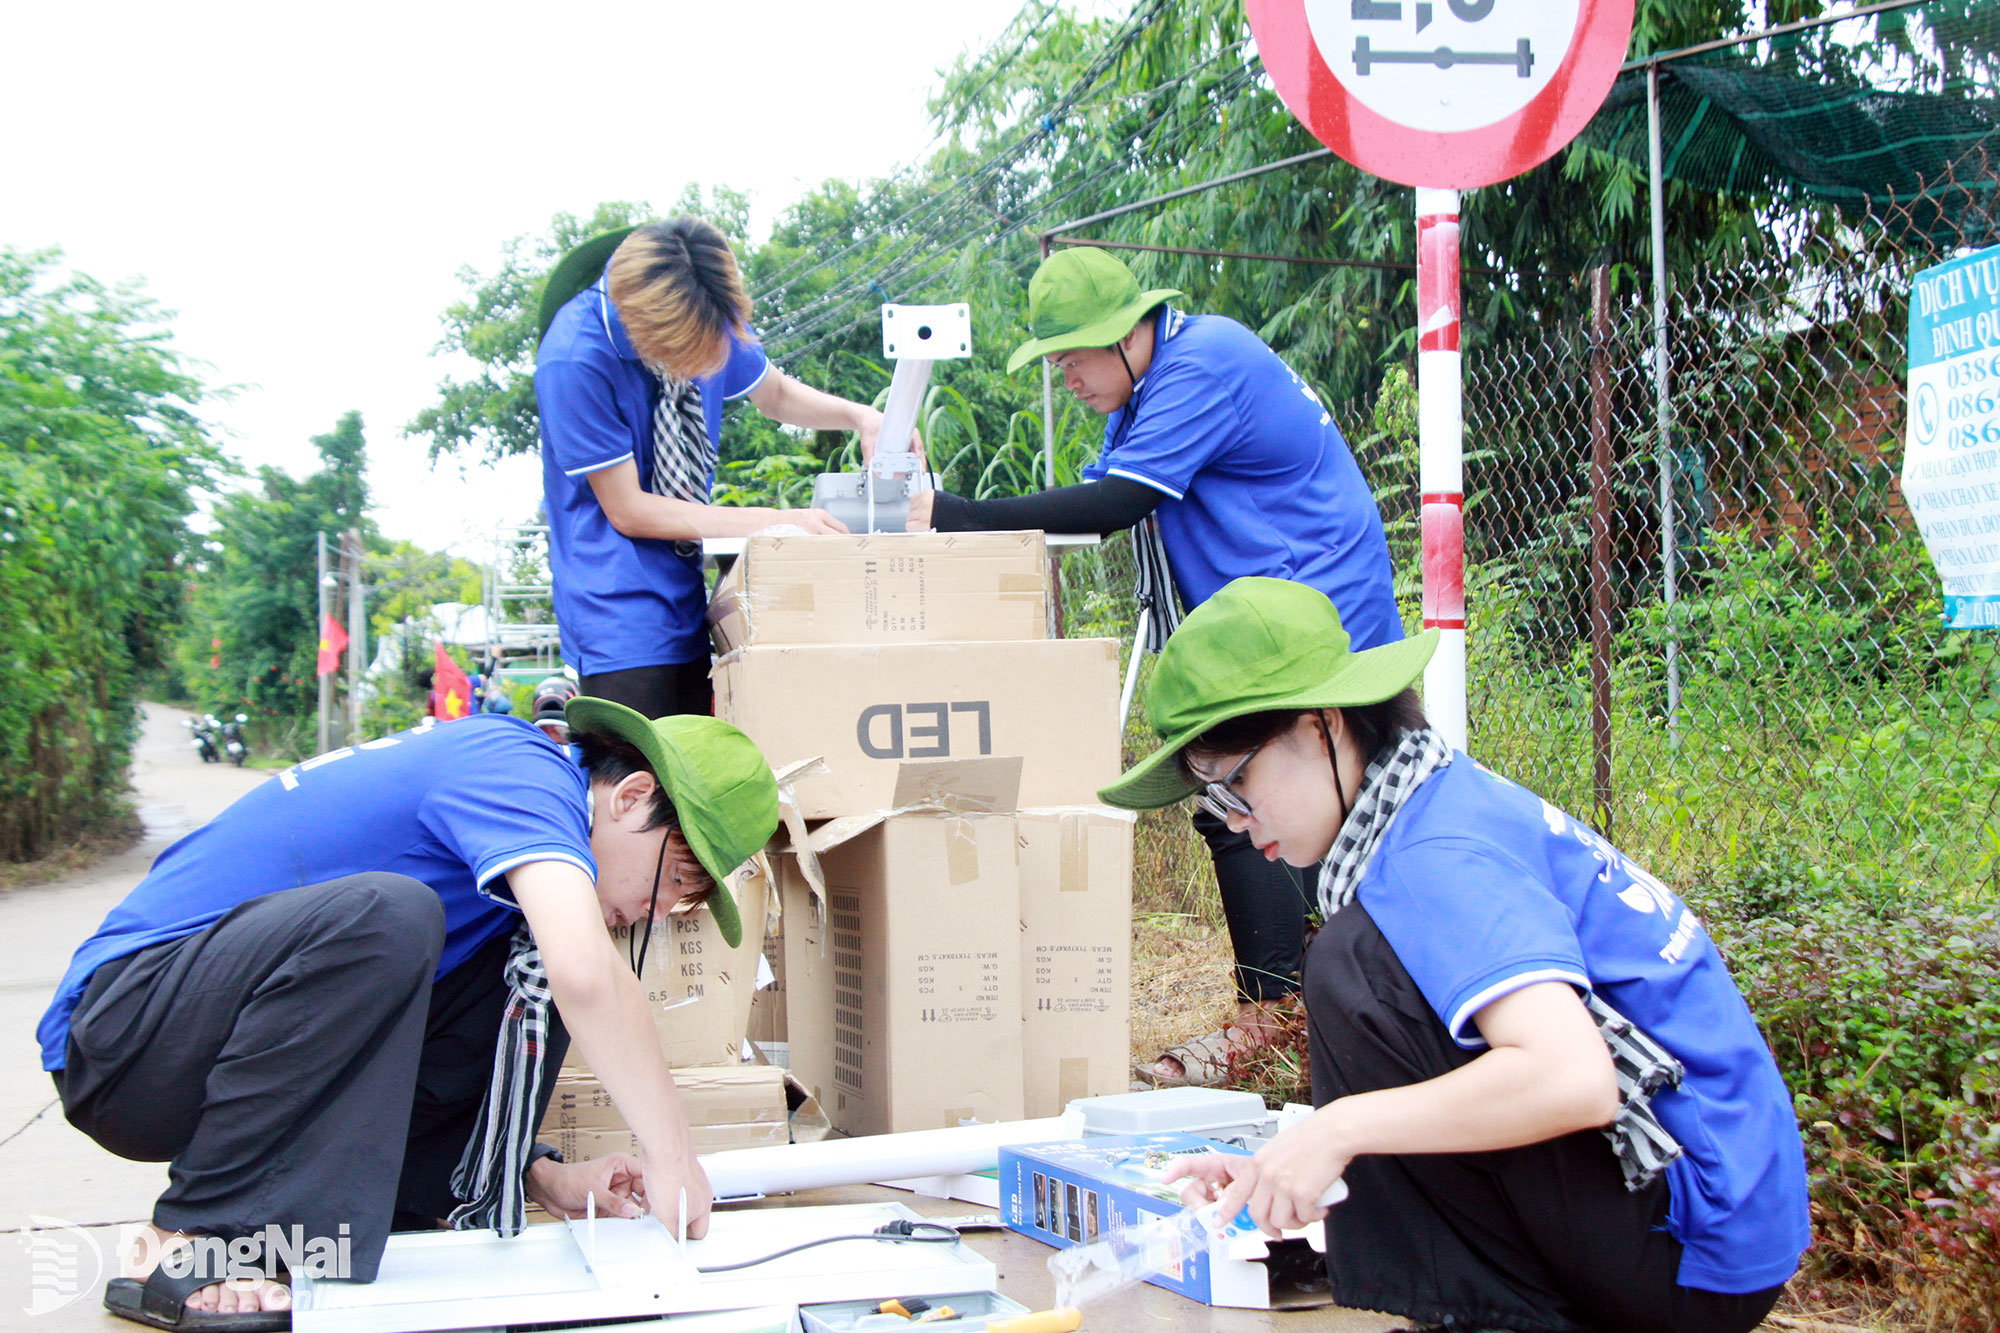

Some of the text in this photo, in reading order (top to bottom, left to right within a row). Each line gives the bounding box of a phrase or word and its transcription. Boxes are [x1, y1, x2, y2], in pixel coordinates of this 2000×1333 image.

[1918, 255, 2000, 323] DỊCH VỤ
[1947, 387, 2000, 421] 086
[857, 700, 992, 760] LED
[677, 920, 700, 934] PCS
[680, 941, 703, 955] KGS
[681, 962, 704, 977] KGS
[918, 965, 935, 973] KGS
[687, 984, 705, 998] CM
